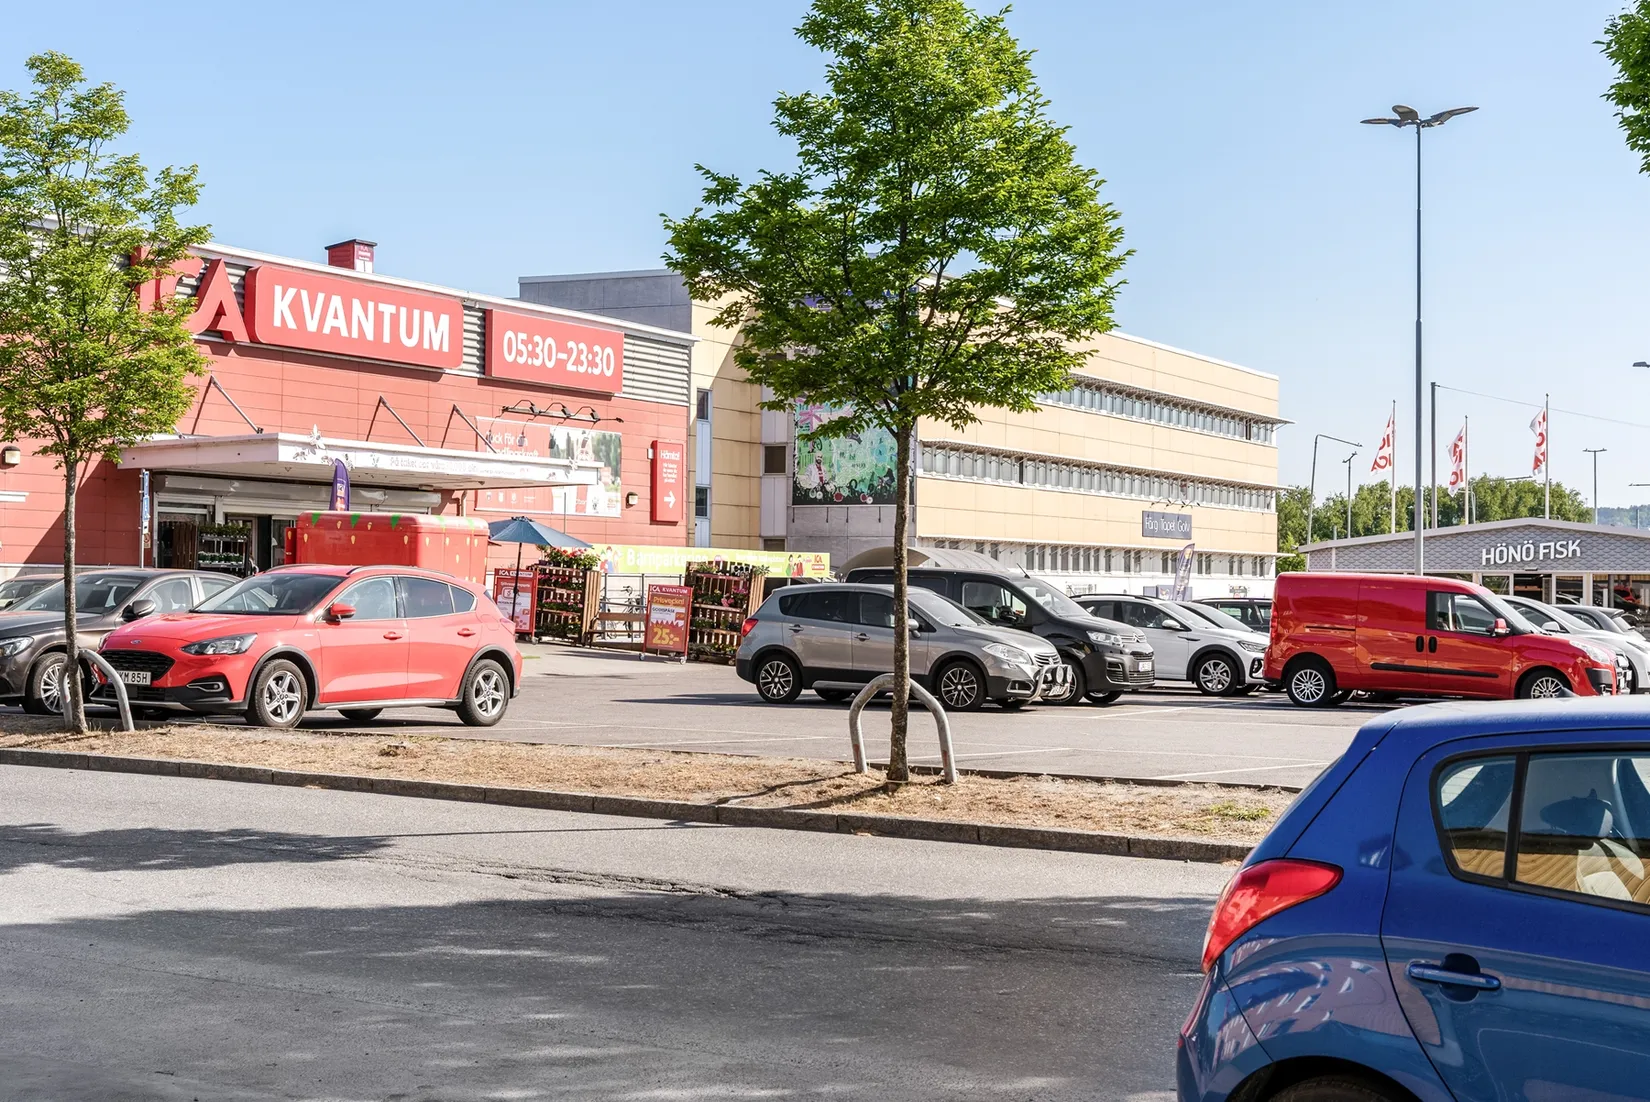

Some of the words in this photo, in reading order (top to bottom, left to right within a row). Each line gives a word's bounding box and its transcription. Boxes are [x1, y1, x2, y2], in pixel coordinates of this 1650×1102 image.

[273, 284, 450, 353] KVANTUM
[1145, 517, 1159, 532] Färg
[1160, 518, 1176, 533] Tapet
[1481, 540, 1535, 566] HÖNÖ
[1539, 539, 1581, 561] FISK
[650, 585, 660, 593] ICA
[662, 586, 688, 594] KVANTUM
[652, 627, 680, 645] 25:-
[131, 673, 148, 684] 85H
